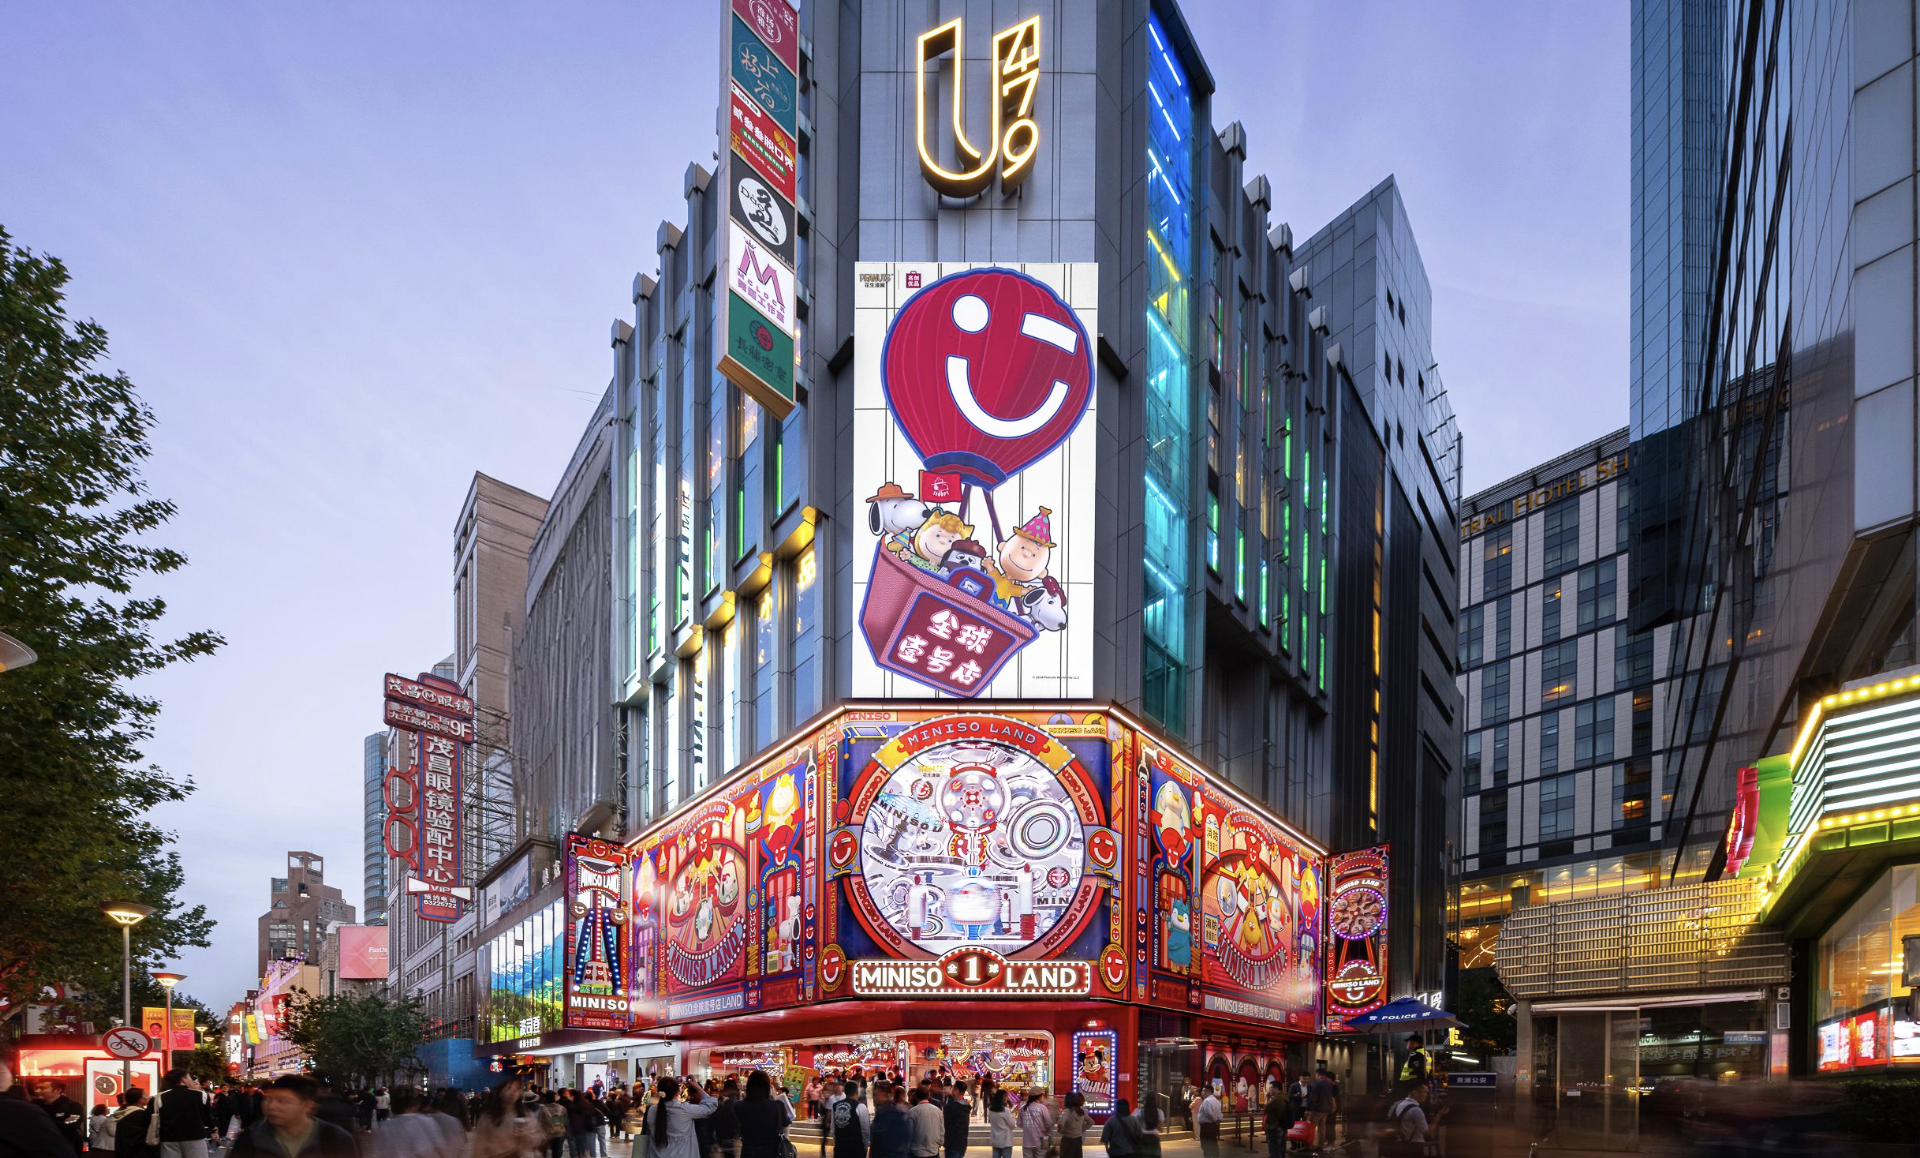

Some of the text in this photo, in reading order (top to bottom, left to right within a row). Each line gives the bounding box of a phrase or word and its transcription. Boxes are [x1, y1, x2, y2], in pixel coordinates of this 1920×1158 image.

[1514, 473, 1588, 516] HOTEL
[928, 609, 992, 654] 全球
[898, 635, 982, 685] 壹号店
[388, 677, 421, 699] 茂昌
[438, 694, 472, 715] 眼镜
[450, 720, 471, 739] 9F
[843, 712, 891, 721] MINISO
[907, 722, 1036, 746] MINISO LAND
[425, 735, 455, 883] 茂昌眼镜验配中心
[879, 800, 929, 830] MINISO
[1077, 793, 1095, 822] LAND
[429, 884, 450, 893] VIP
[603, 870, 619, 892] LAND
[1361, 879, 1380, 887] LAND
[855, 881, 902, 948] MINISO LAND
[1042, 885, 1092, 949] MINISO LAND
[672, 933, 741, 982] MINISO LAND
[861, 967, 943, 987] MINISO
[965, 956, 981, 981] 1
[1006, 967, 1077, 987] LAND
[1218, 938, 1282, 984] MINISO LAND
[1332, 979, 1380, 989] MINISO LAND
[571, 995, 628, 1011] MINISO
[722, 994, 742, 1009] LAND
[1214, 997, 1238, 1012] MINISO
[1264, 1007, 1280, 1021] LAND
[1382, 1013, 1417, 1021] POLICE
